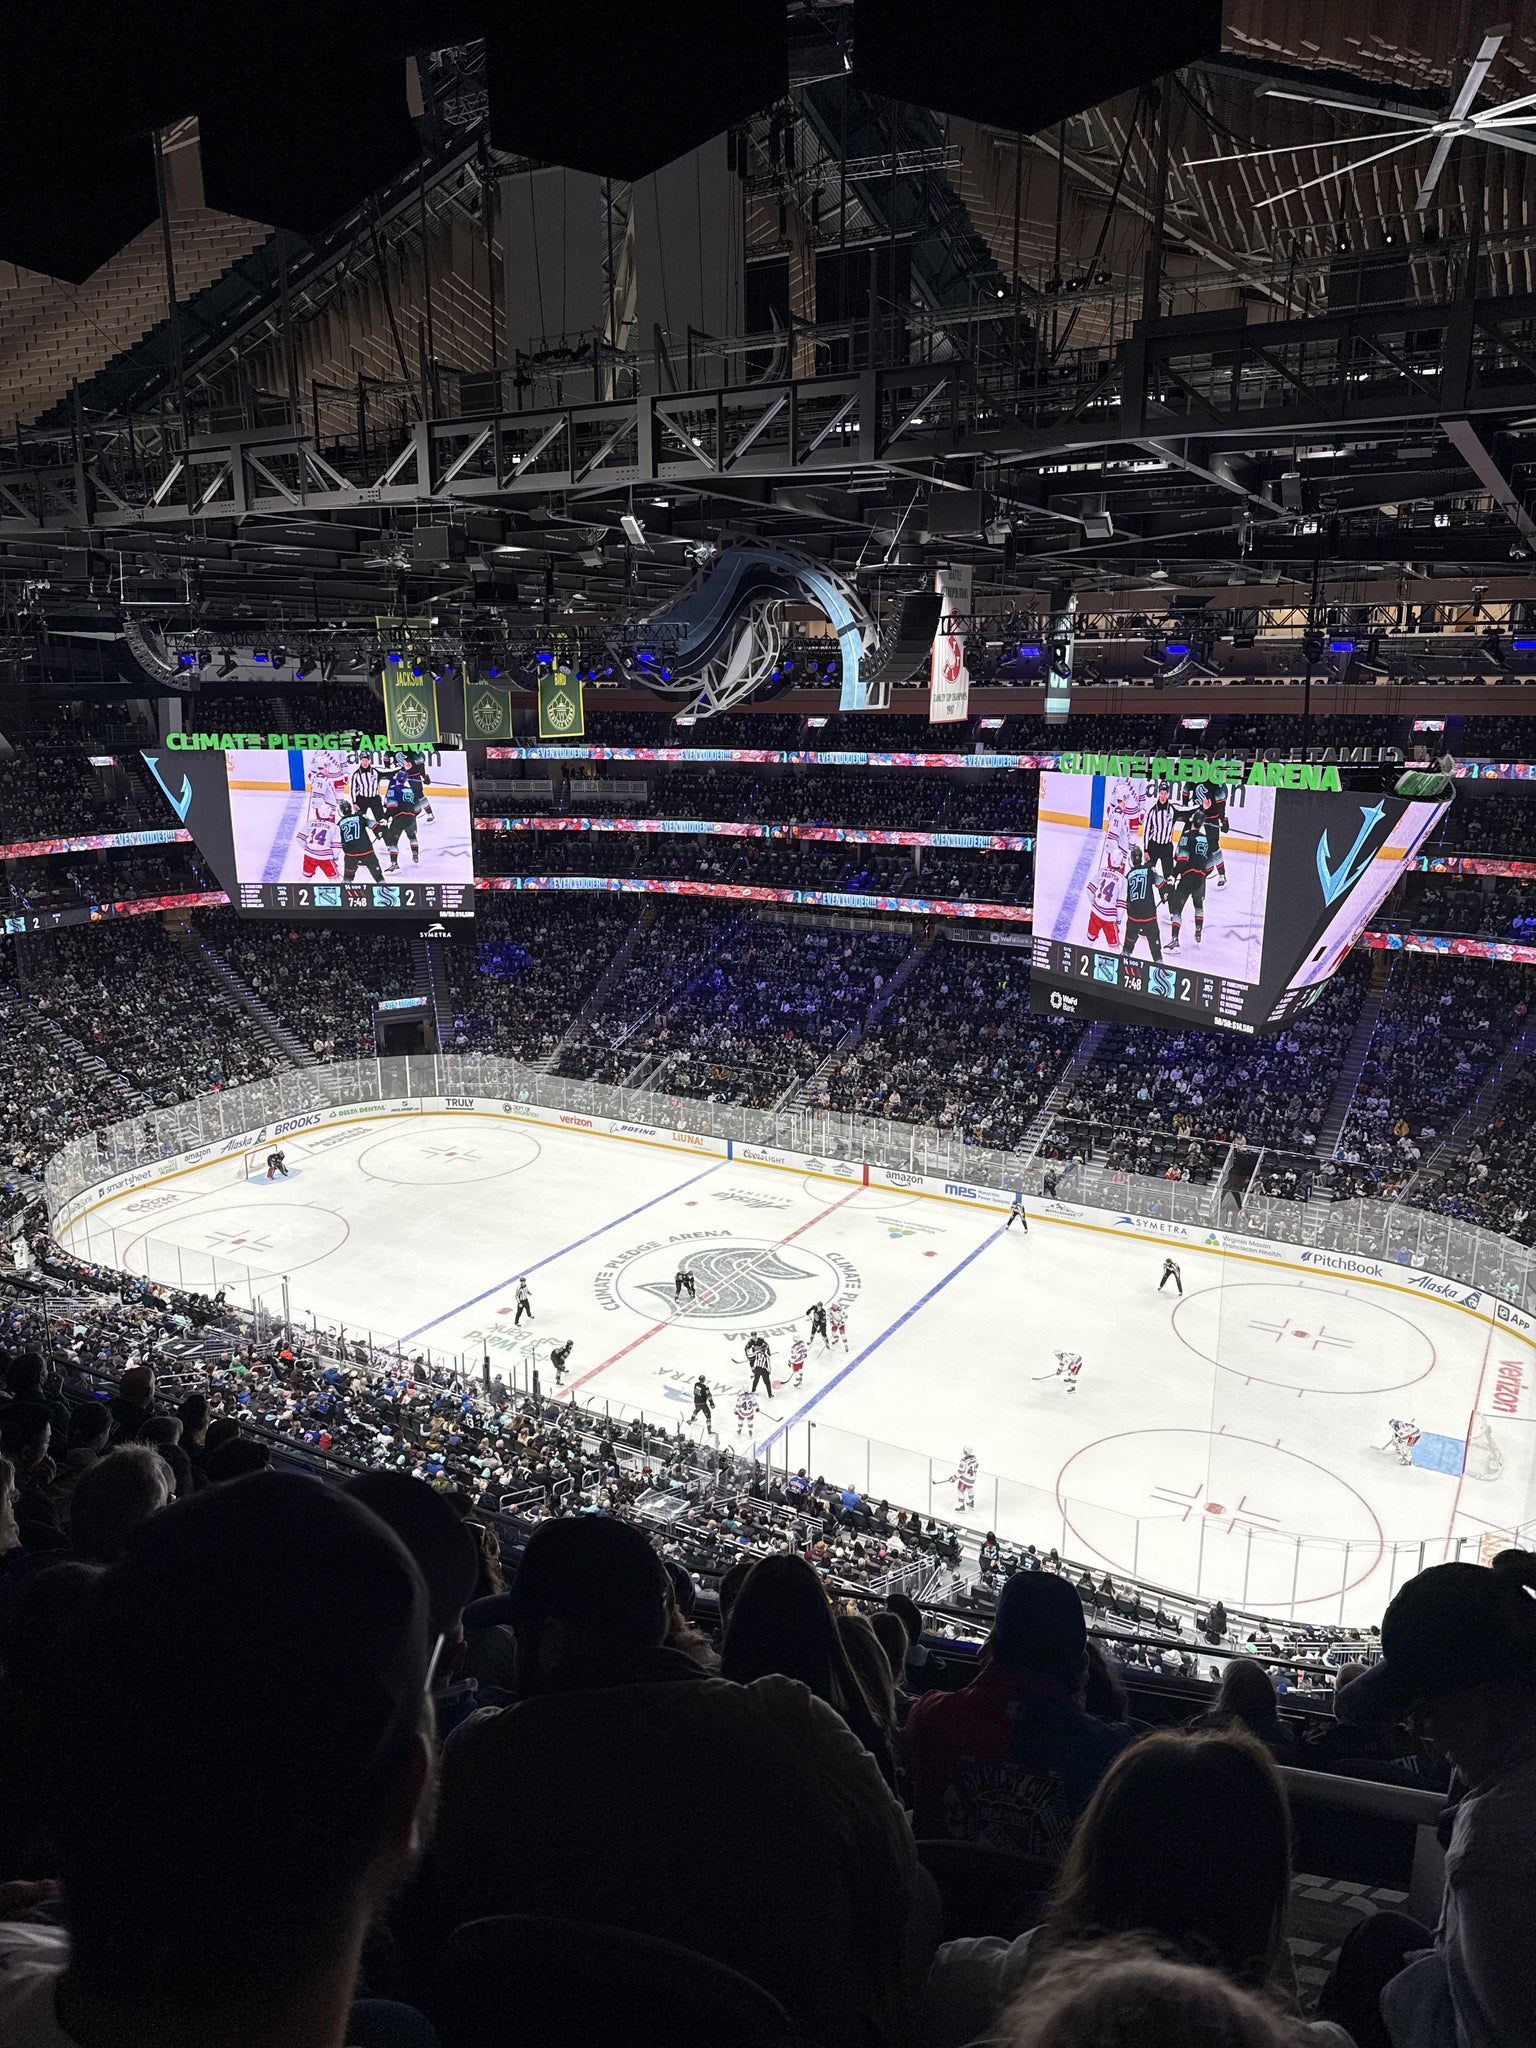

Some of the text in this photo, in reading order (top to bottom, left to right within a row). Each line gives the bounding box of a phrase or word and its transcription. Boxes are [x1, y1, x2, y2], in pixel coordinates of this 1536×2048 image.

[166, 733, 261, 750] CLIMATE
[267, 733, 353, 750] PLEDGE
[1060, 752, 1342, 793] CLIMATE PLEDGE ARENA
[309, 828, 327, 845] 14
[341, 823, 360, 843] 27
[1097, 879, 1116, 903] 14
[1129, 876, 1148, 901] 27
[299, 889, 309, 906] 2
[348, 897, 367, 907] 7:48
[405, 890, 415, 906] 2
[32, 917, 40, 929] 2
[1080, 955, 1089, 976] 2
[1140, 961, 1144, 969] 7
[1124, 975, 1142, 991] 7:48
[1180, 978, 1191, 1001] 2
[1062, 1003, 1076, 1013] Bank
[338, 1104, 386, 1117] DELTA DENTAL
[445, 1098, 474, 1107] TRULY
[274, 1113, 321, 1136] BROOKS
[559, 1114, 593, 1128] verizon
[620, 1125, 657, 1136] BOEING
[220, 1136, 253, 1154] Alaska
[184, 1147, 211, 1162] amazon
[743, 1147, 785, 1165] Coors LIGHT
[106, 1169, 152, 1194] smartsheet
[885, 1169, 924, 1186] amazon
[1136, 1218, 1188, 1236] SYMETRA
[1222, 1234, 1271, 1250] Virginia Mason
[1222, 1241, 1282, 1258] Franciscan Health
[593, 1229, 734, 1311] CLIMATE PLEDGE ARENA
[826, 1252, 862, 1289] CLIMATE
[1313, 1253, 1384, 1278] PitchBook
[1407, 1275, 1458, 1299] Alaska
[1491, 1359, 1529, 1413] verizon
